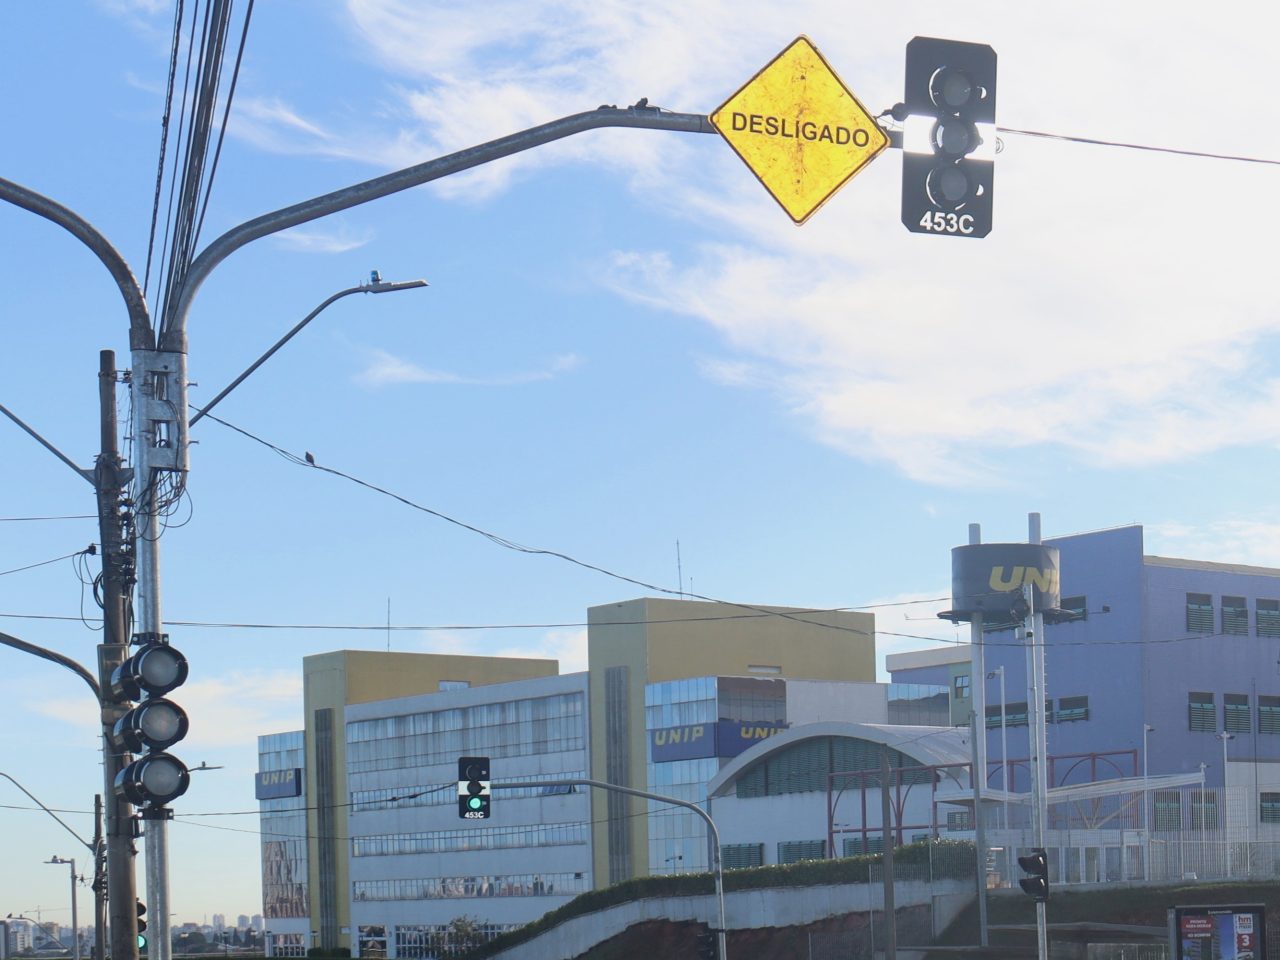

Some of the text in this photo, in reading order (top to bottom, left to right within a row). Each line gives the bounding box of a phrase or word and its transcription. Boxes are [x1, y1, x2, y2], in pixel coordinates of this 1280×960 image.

[732, 112, 870, 148] DESLIGADO
[919, 210, 975, 234] 453C
[655, 726, 705, 746] UNIP
[262, 770, 294, 785] UNIP
[464, 811, 485, 819] 453C
[1241, 934, 1250, 947] 3
